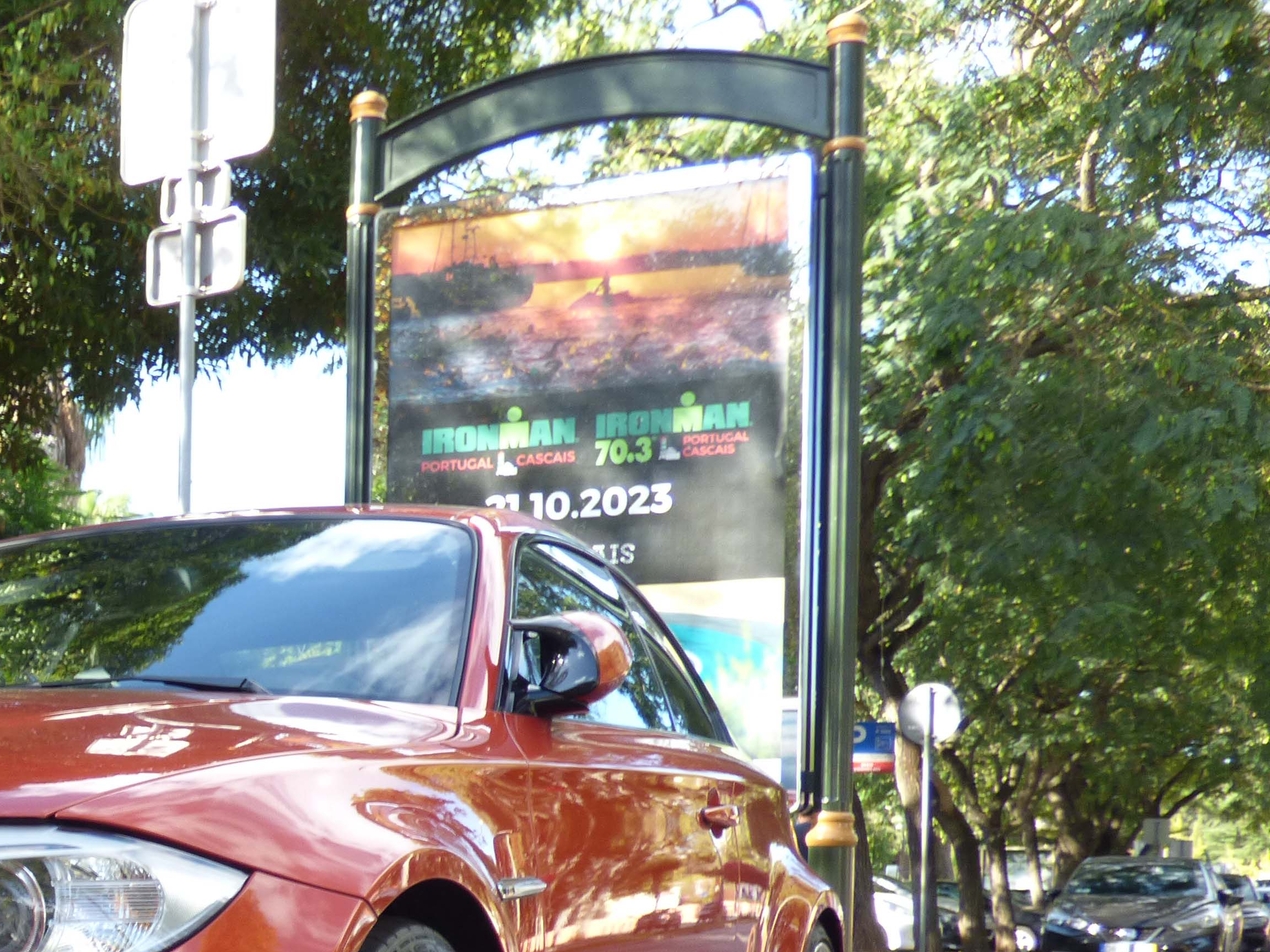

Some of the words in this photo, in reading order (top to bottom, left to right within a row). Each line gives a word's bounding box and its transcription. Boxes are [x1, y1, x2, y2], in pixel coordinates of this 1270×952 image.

[595, 391, 750, 439] IRONMAN
[422, 406, 576, 455] IRONMAN
[683, 431, 750, 445] PORTUGAL
[421, 457, 494, 473] PORTUGAL
[516, 451, 576, 466] CASCAIS
[595, 436, 653, 467] 70.3
[683, 443, 736, 458] CASCAIS
